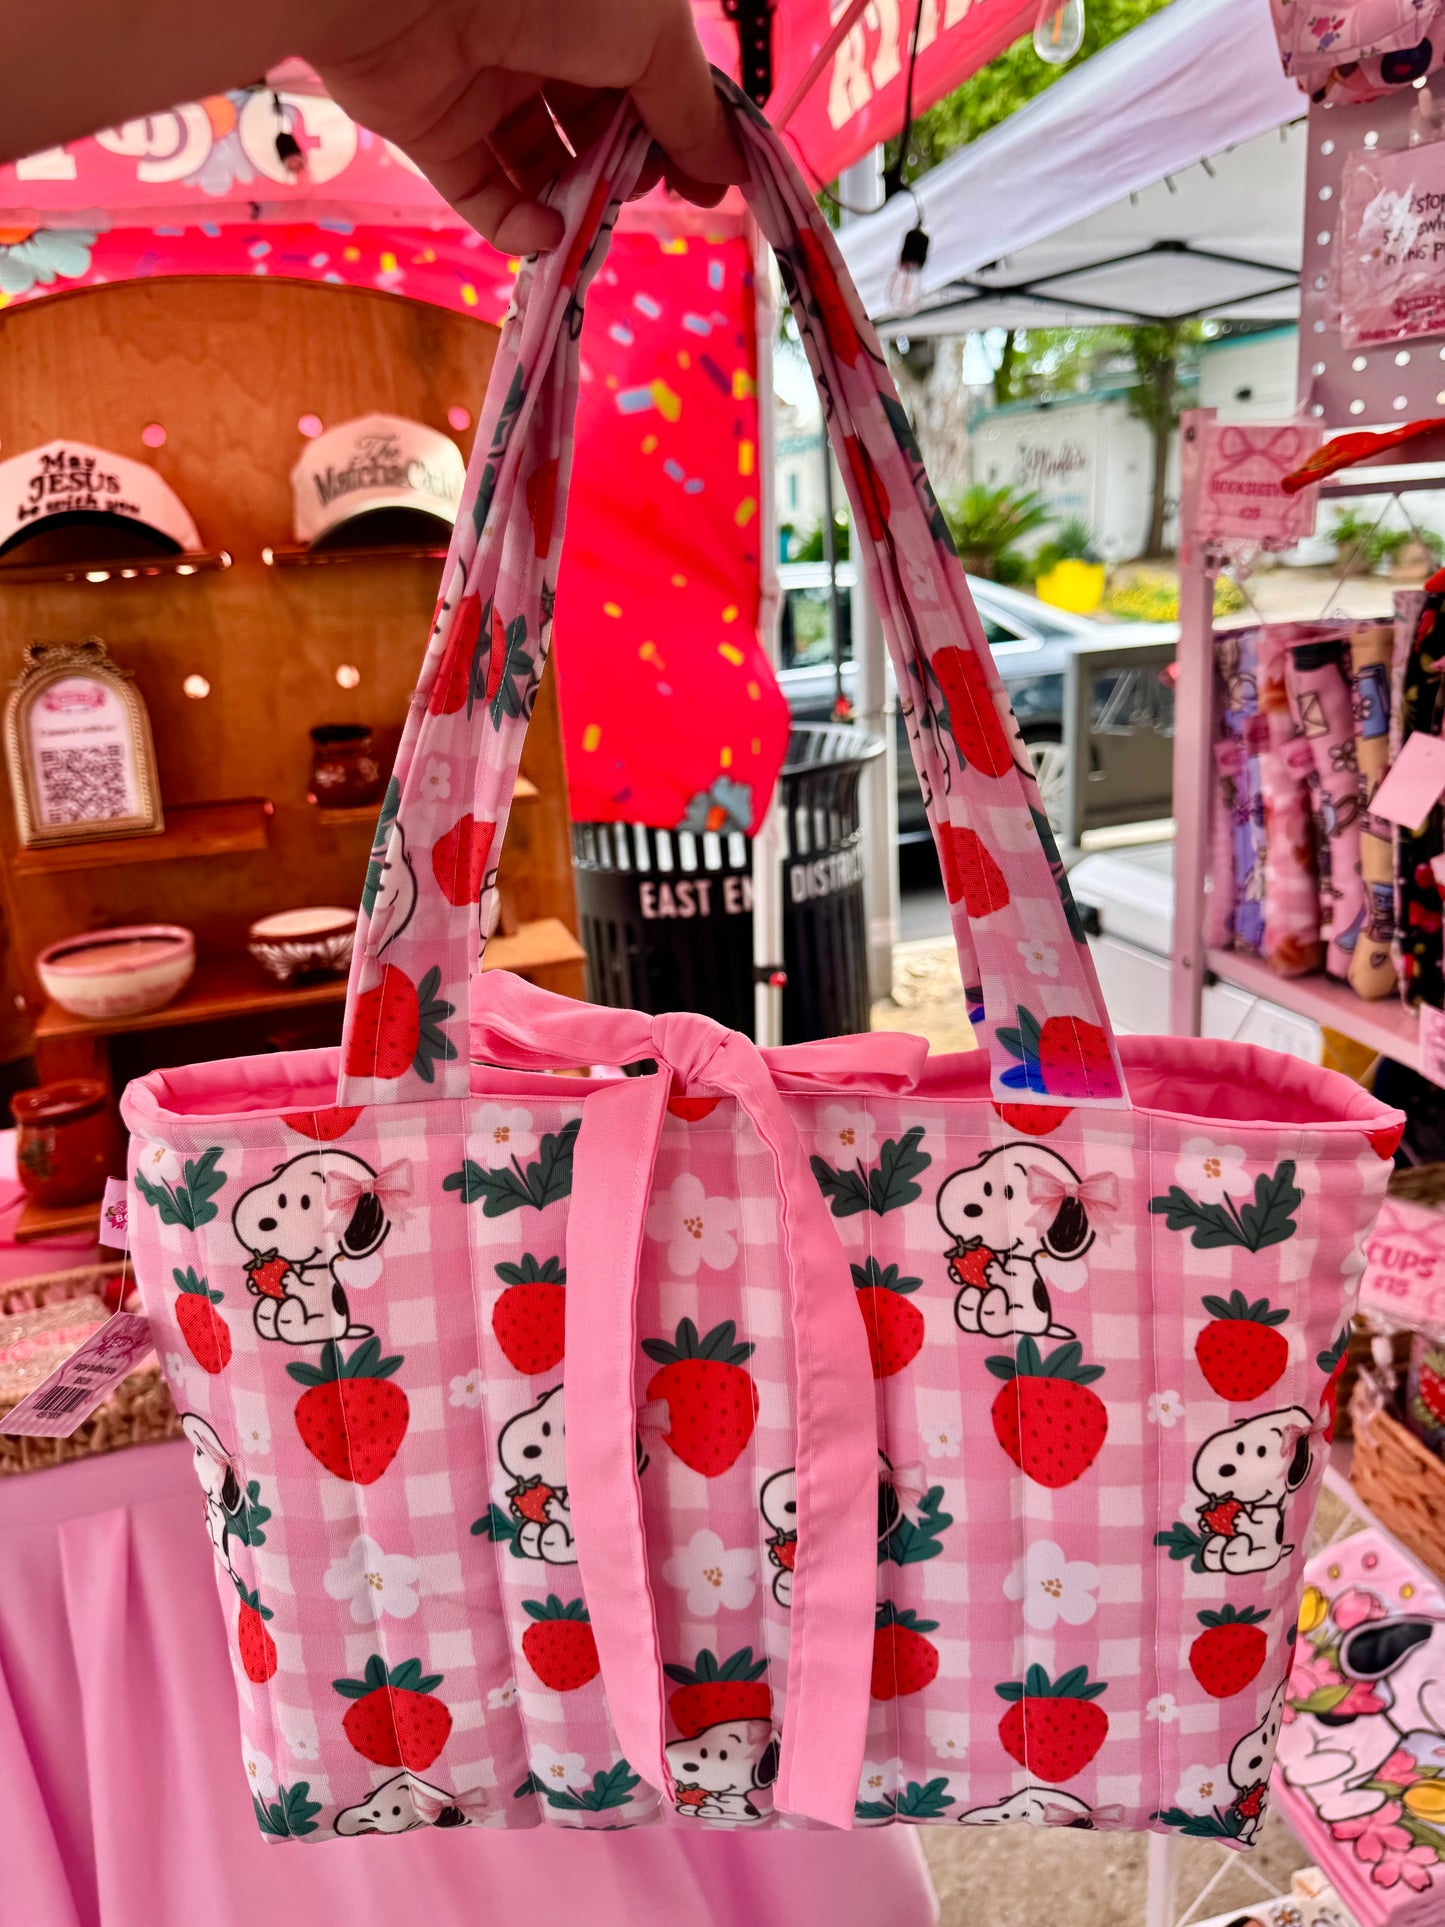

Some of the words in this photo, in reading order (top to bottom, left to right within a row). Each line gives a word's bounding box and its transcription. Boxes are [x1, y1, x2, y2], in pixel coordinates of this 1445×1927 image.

[41, 451, 96, 475] May
[28, 472, 121, 503] JESUS
[638, 879, 712, 920] EAST
[722, 875, 754, 915] EN
[1366, 1240, 1437, 1279] CUPS
